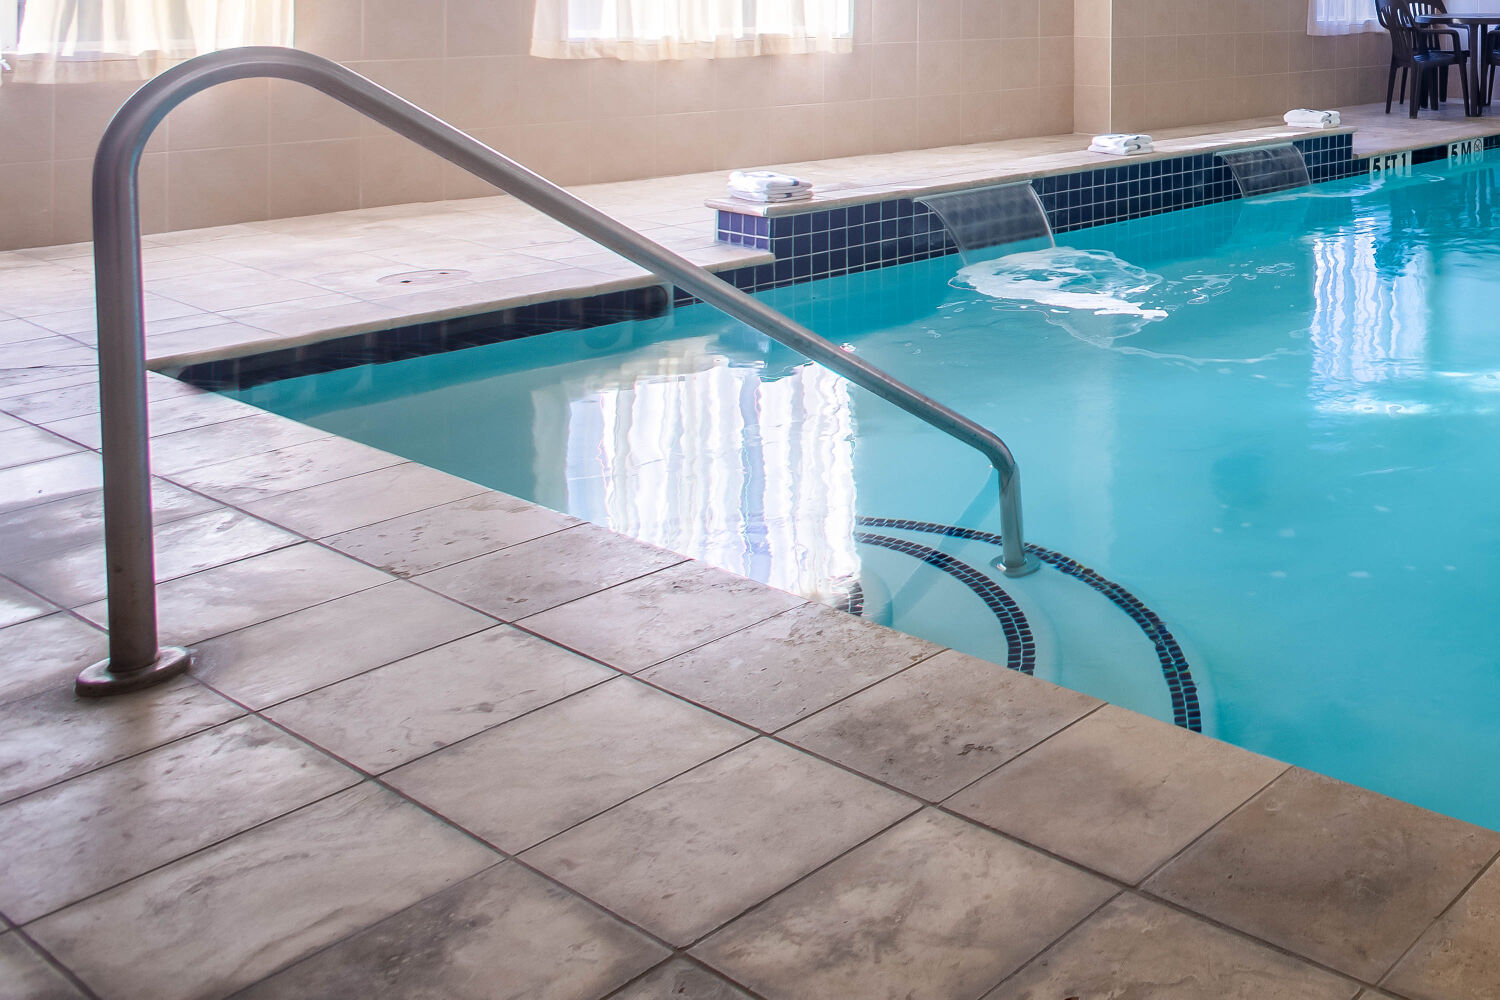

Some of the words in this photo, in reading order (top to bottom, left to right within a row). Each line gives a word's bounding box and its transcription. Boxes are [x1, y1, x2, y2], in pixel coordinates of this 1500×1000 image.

[1452, 145, 1458, 157] 5
[1461, 141, 1472, 156] M
[1372, 157, 1382, 171] 5
[1384, 154, 1398, 170] FT
